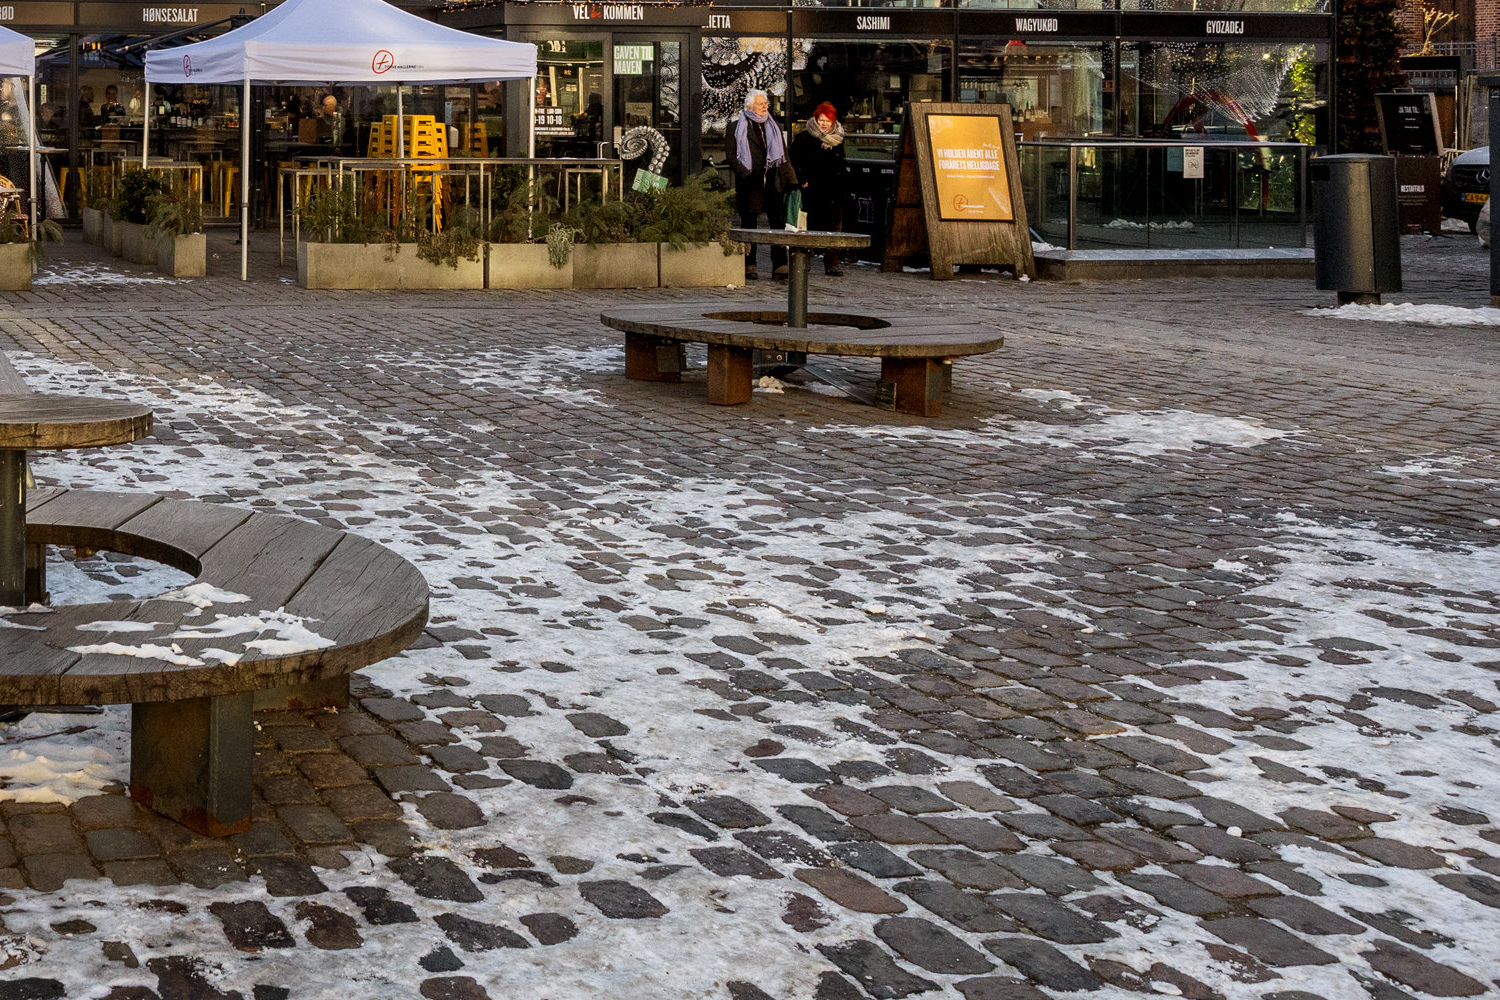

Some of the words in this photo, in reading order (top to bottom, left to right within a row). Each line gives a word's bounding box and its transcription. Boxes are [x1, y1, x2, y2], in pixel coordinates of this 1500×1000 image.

[142, 7, 198, 22] HØNSESALAT
[572, 4, 590, 20] VEL
[603, 4, 644, 20] KOMMEN
[856, 16, 890, 30] SASHIMI
[1015, 18, 1058, 32] WAGYUKØD
[1206, 20, 1244, 34] GYOZADEJ
[614, 45, 639, 60] GAVEN
[641, 46, 654, 60] TIL
[614, 60, 642, 75] MAVEN
[936, 148, 944, 158] VI
[944, 148, 966, 159] HOLDER
[966, 147, 984, 159] ÅBENT
[985, 149, 999, 160] ALLE
